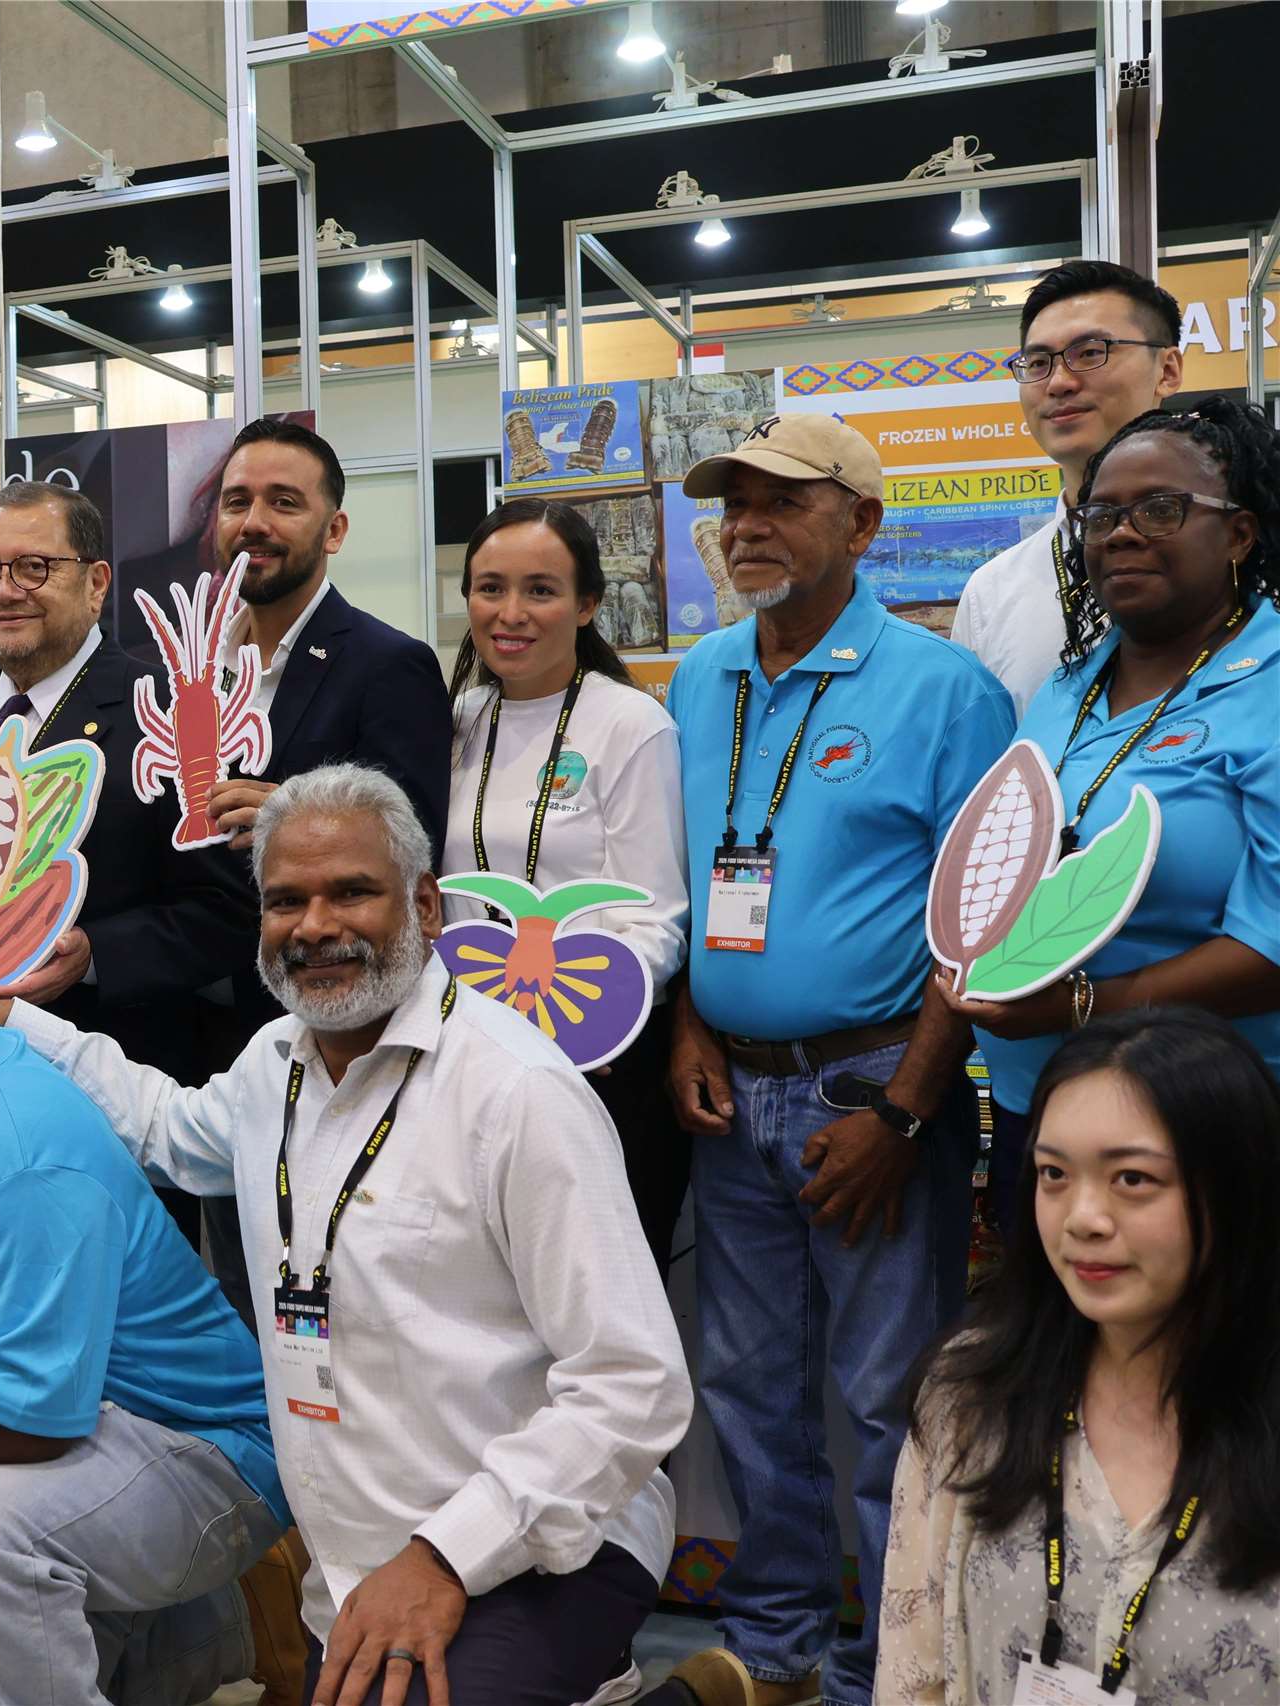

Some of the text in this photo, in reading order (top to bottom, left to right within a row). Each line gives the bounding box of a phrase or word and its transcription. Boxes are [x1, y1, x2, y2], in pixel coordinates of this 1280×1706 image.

[577, 384, 615, 398] Pride
[878, 427, 947, 446] FROZEN
[951, 422, 1015, 441] WHOLE
[980, 469, 1052, 497] PRIDE
[883, 508, 916, 518] AUGHT
[923, 506, 977, 516] CARIBBEAN
[980, 503, 1008, 512] SPINY
[717, 940, 752, 949] EXHIBITOR
[296, 1403, 327, 1417] EXHIBITOR
[1050, 1538, 1060, 1577] TAITRA
